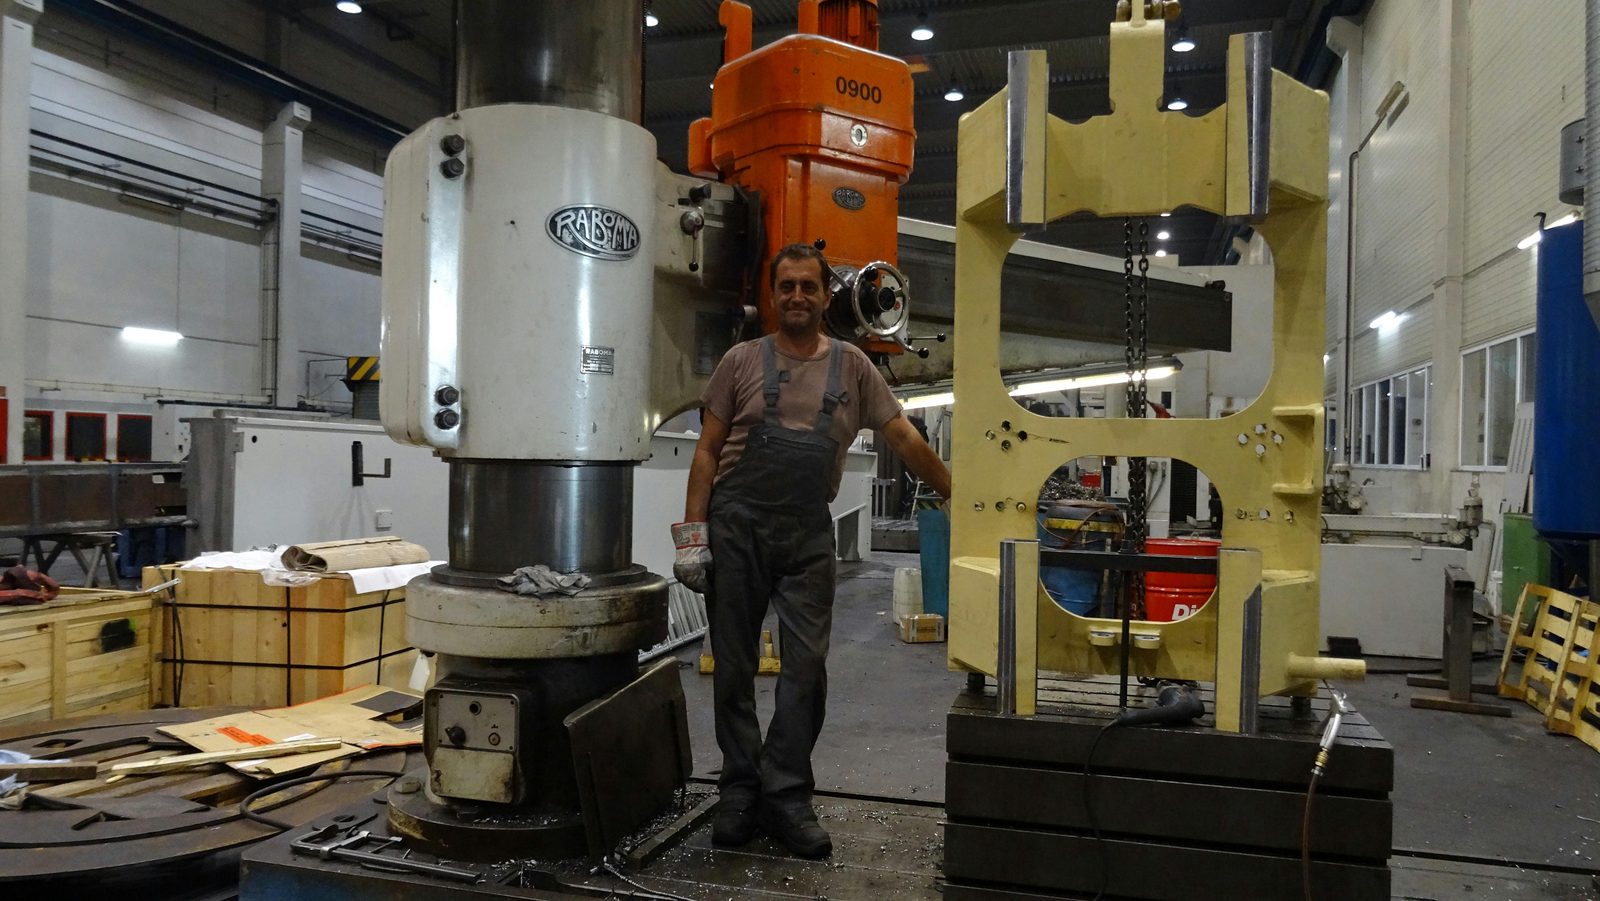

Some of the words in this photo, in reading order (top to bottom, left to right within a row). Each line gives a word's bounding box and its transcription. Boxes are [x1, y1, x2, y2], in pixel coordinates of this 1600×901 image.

[836, 76, 882, 104] 0900
[554, 209, 638, 254] RABOMA
[1171, 604, 1199, 621] Di
